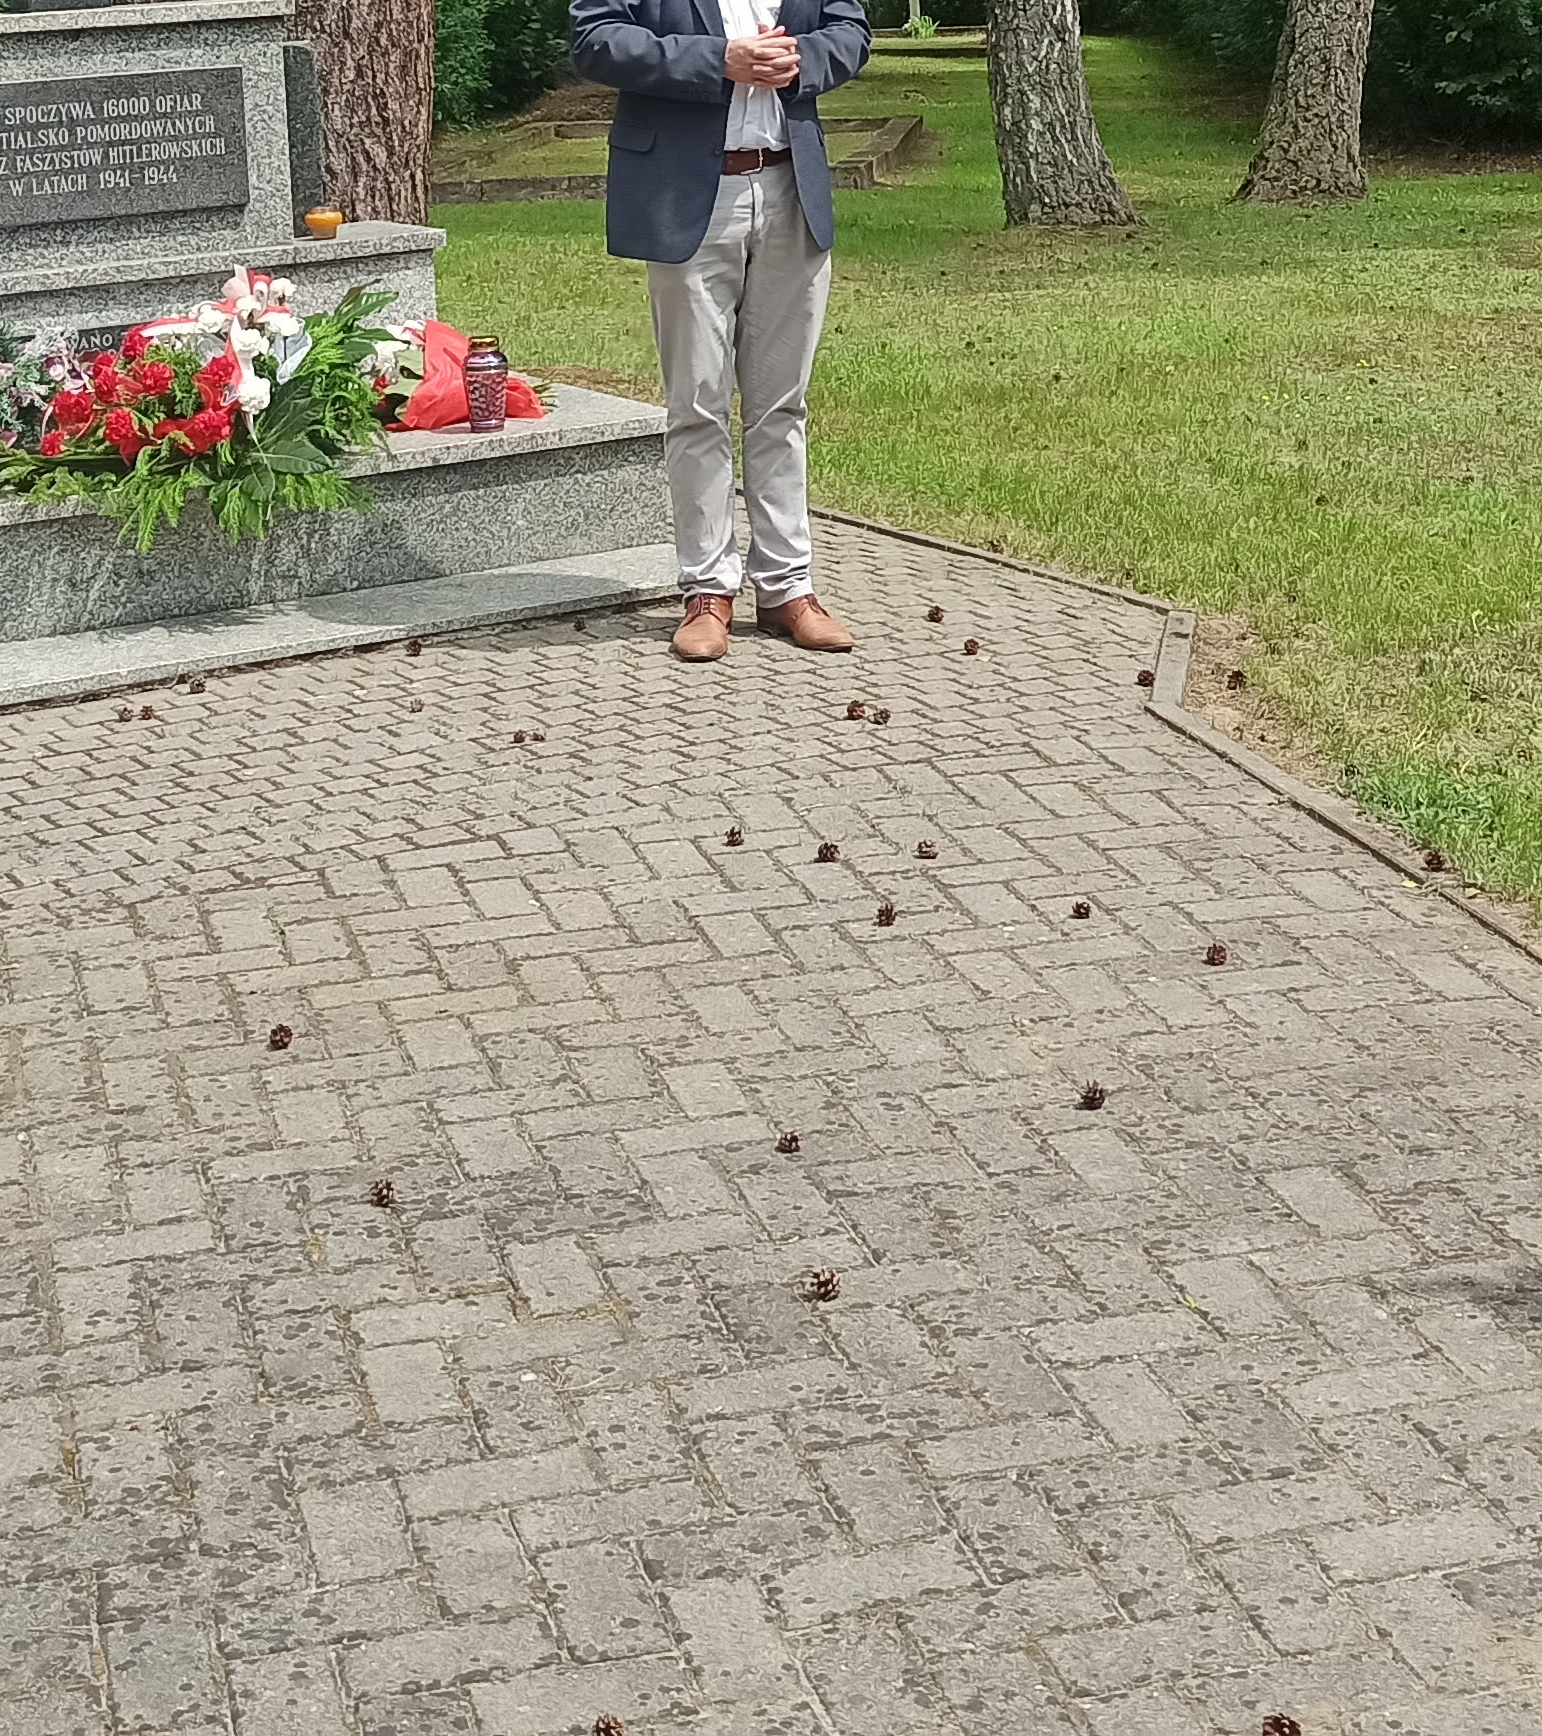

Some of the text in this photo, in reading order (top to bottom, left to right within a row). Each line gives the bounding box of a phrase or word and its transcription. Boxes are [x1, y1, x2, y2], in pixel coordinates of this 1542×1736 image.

[4, 101, 96, 125] SPOCZYWA
[102, 96, 150, 118] 16000
[155, 93, 203, 113] OFIAR
[76, 114, 216, 144] POMORDOWANYCH
[108, 137, 227, 165] HITLEROWSKICH
[8, 178, 26, 197] W
[32, 173, 87, 195] LATACH
